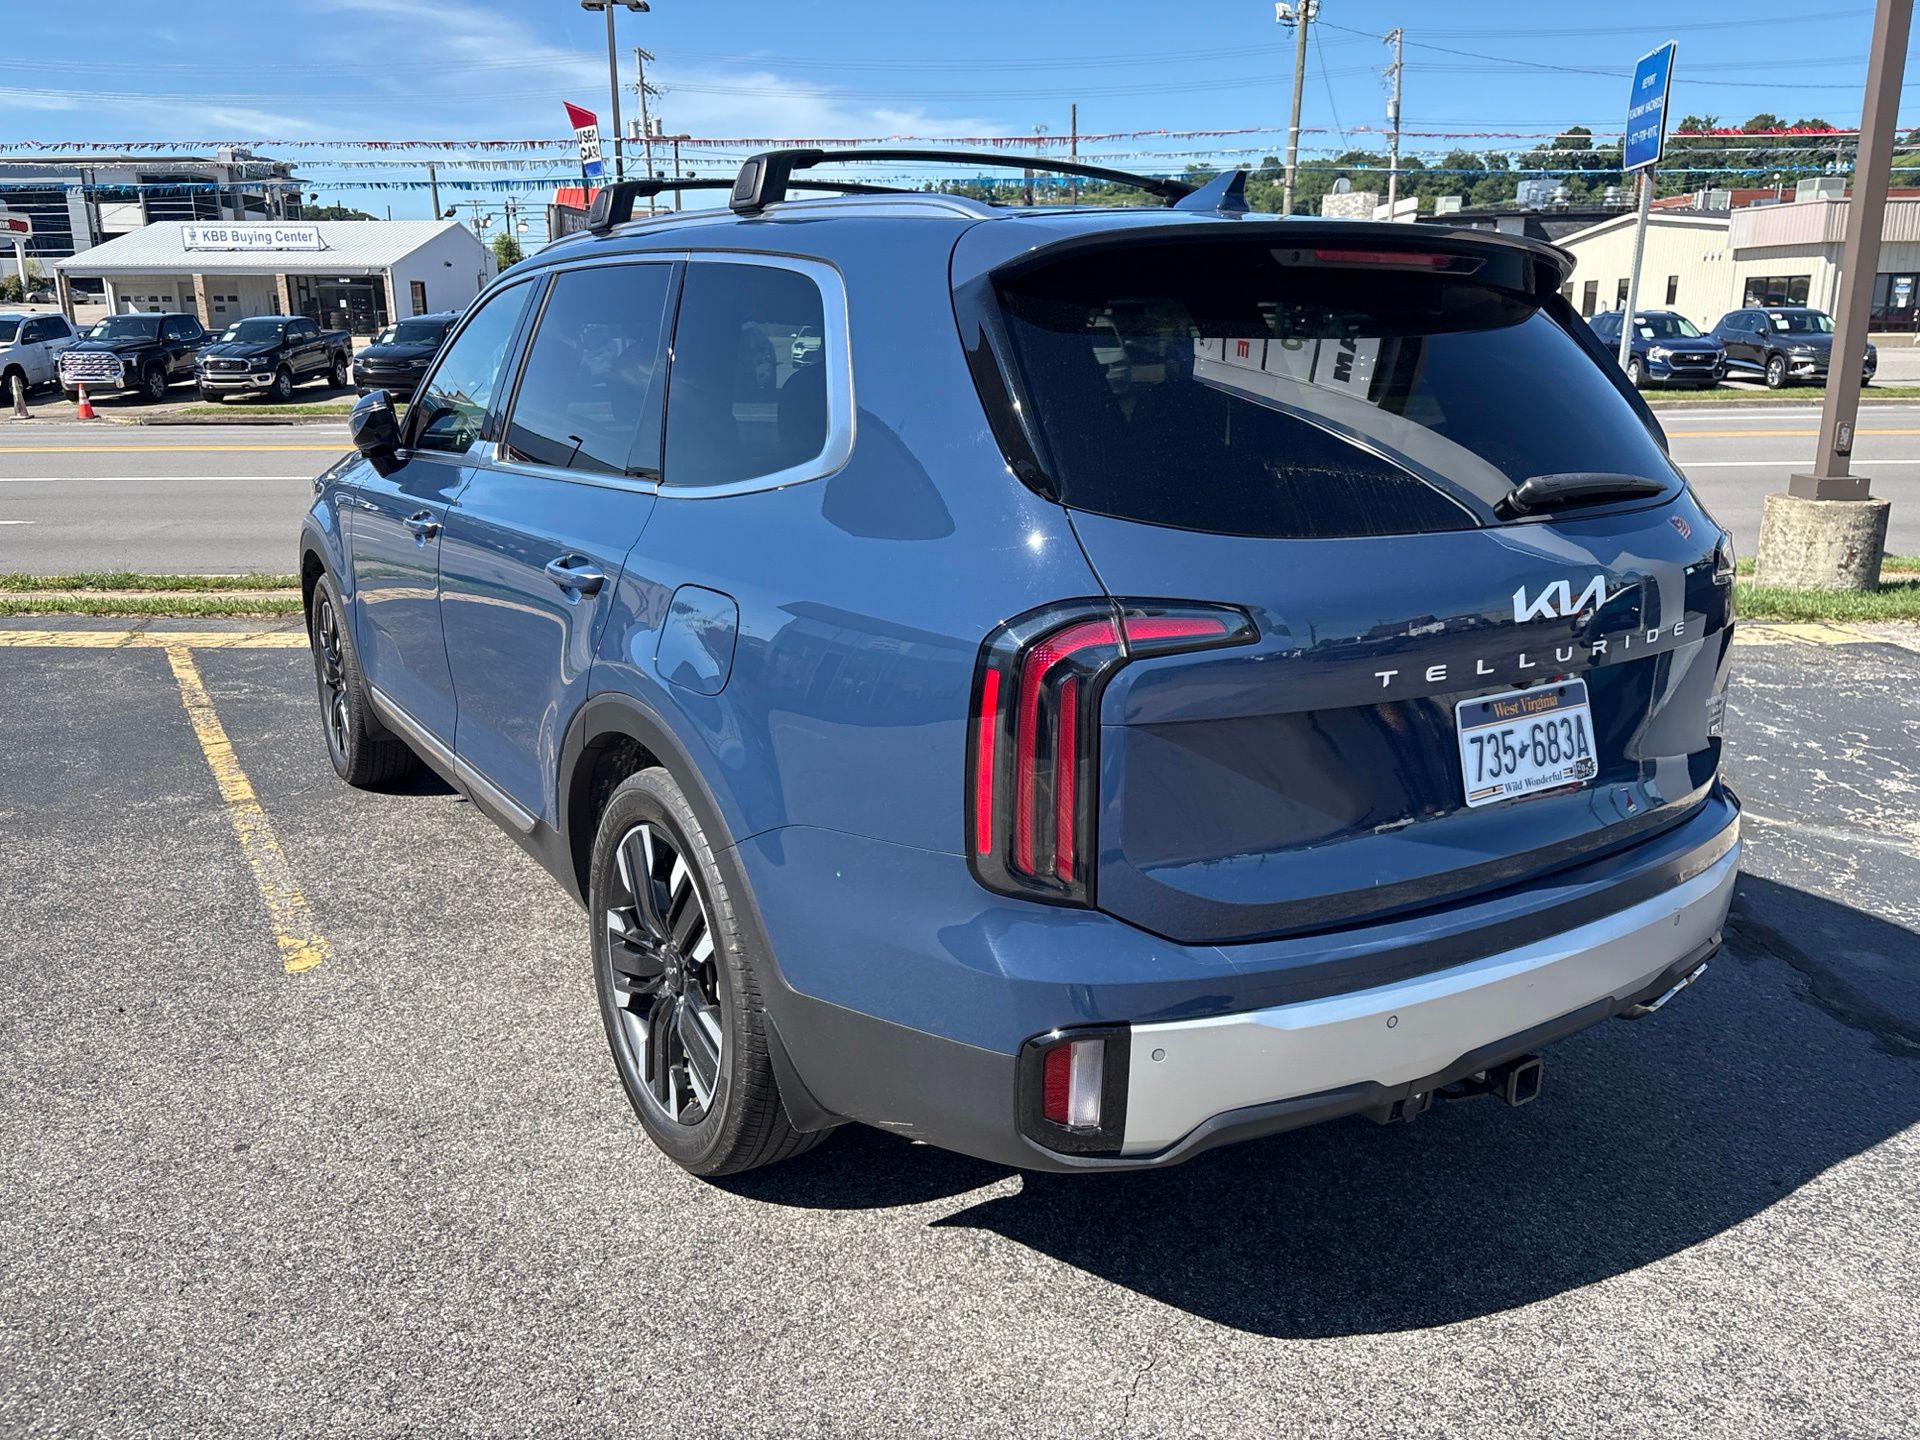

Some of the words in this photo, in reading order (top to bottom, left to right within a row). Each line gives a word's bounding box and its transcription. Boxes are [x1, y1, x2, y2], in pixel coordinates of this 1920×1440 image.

[202, 230, 228, 242] KBB
[231, 231, 273, 245] Buying
[275, 230, 313, 243] Center
[1512, 574, 1607, 623] KIA
[1375, 621, 1685, 688] TELLURIDE
[1493, 702, 1519, 718] West
[1521, 692, 1558, 712] Virginia
[1504, 782, 1523, 793] Wild
[1524, 771, 1563, 788] Wonderful
